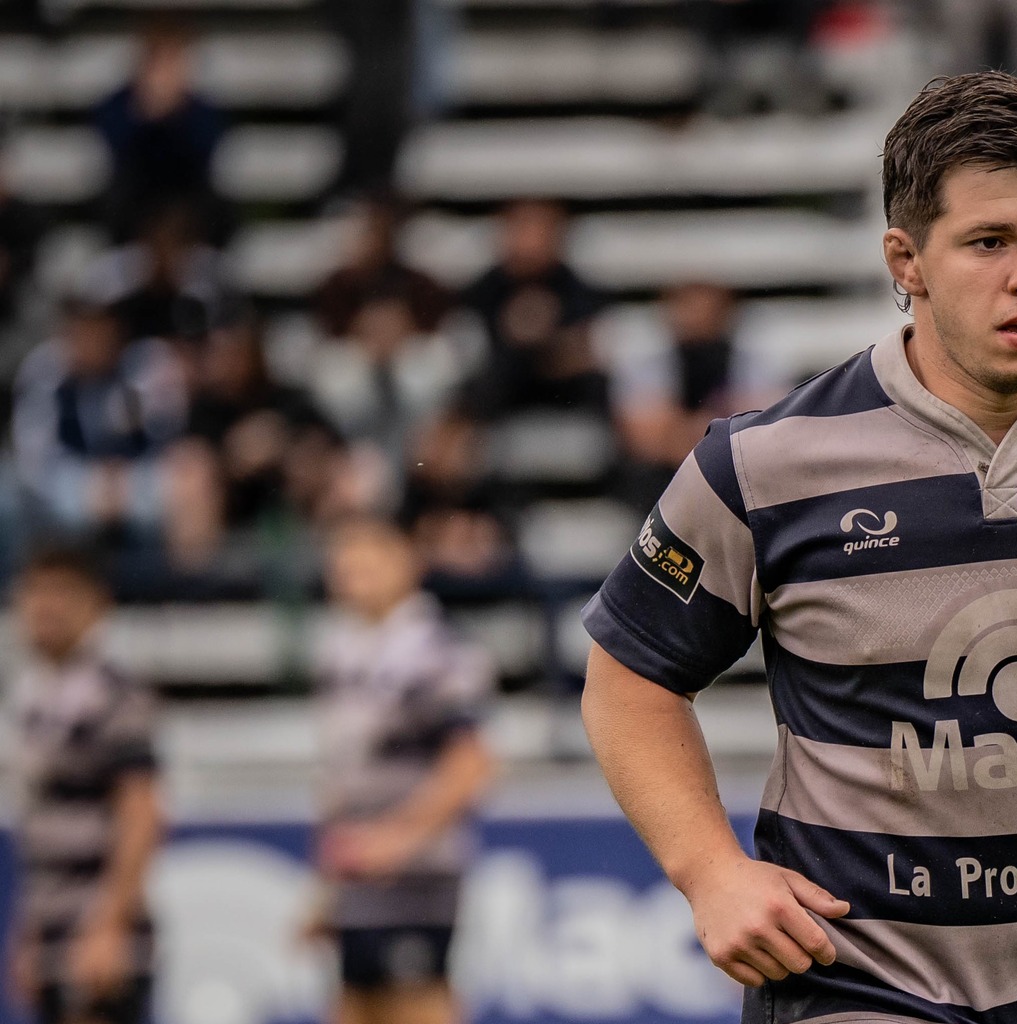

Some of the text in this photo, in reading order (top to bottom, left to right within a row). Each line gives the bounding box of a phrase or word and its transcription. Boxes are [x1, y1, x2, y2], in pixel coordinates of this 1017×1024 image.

[843, 535, 900, 555] quince
[658, 561, 689, 585] .com
[887, 853, 931, 898] La
